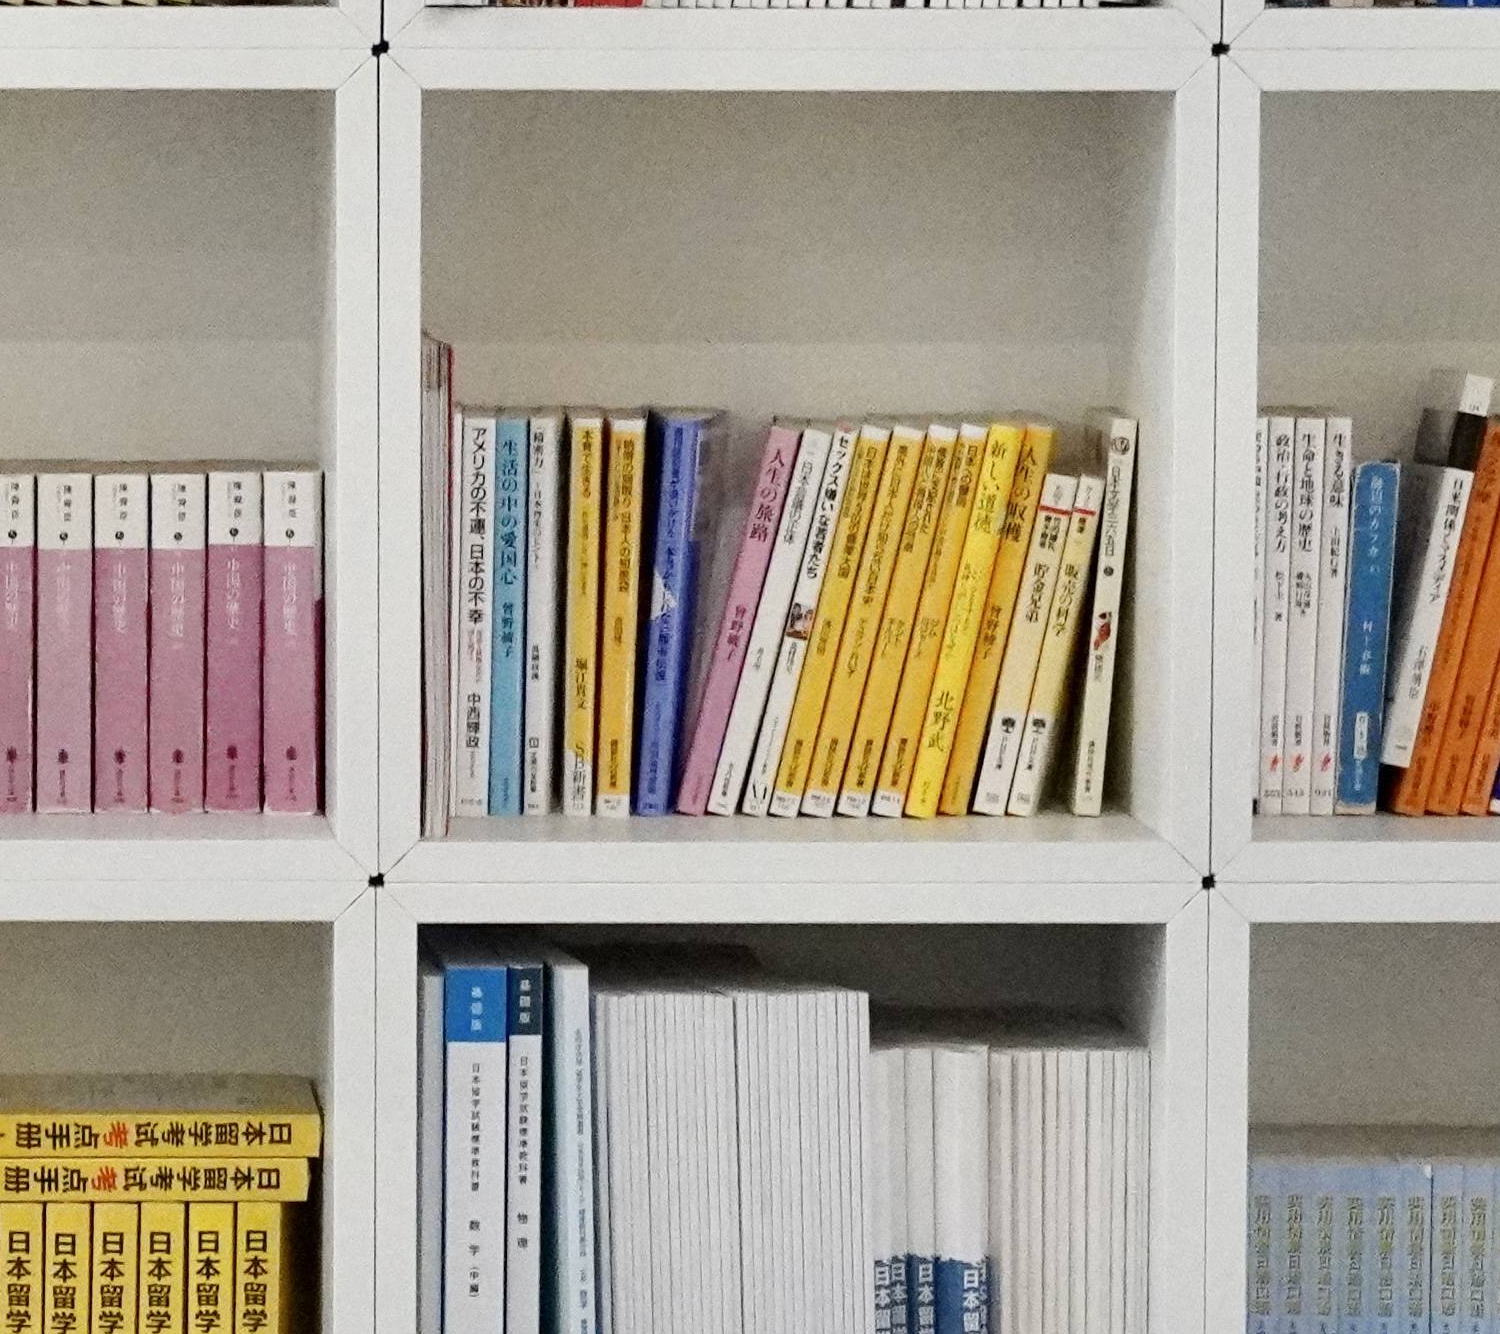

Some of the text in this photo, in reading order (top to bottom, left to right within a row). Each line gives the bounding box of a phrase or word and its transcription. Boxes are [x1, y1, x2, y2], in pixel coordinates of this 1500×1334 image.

[926, 689, 955, 752] 北野武
[14, 1121, 293, 1150] 日本留学考试考点手册
[2, 1165, 282, 1194] 日本留学考试考点手册
